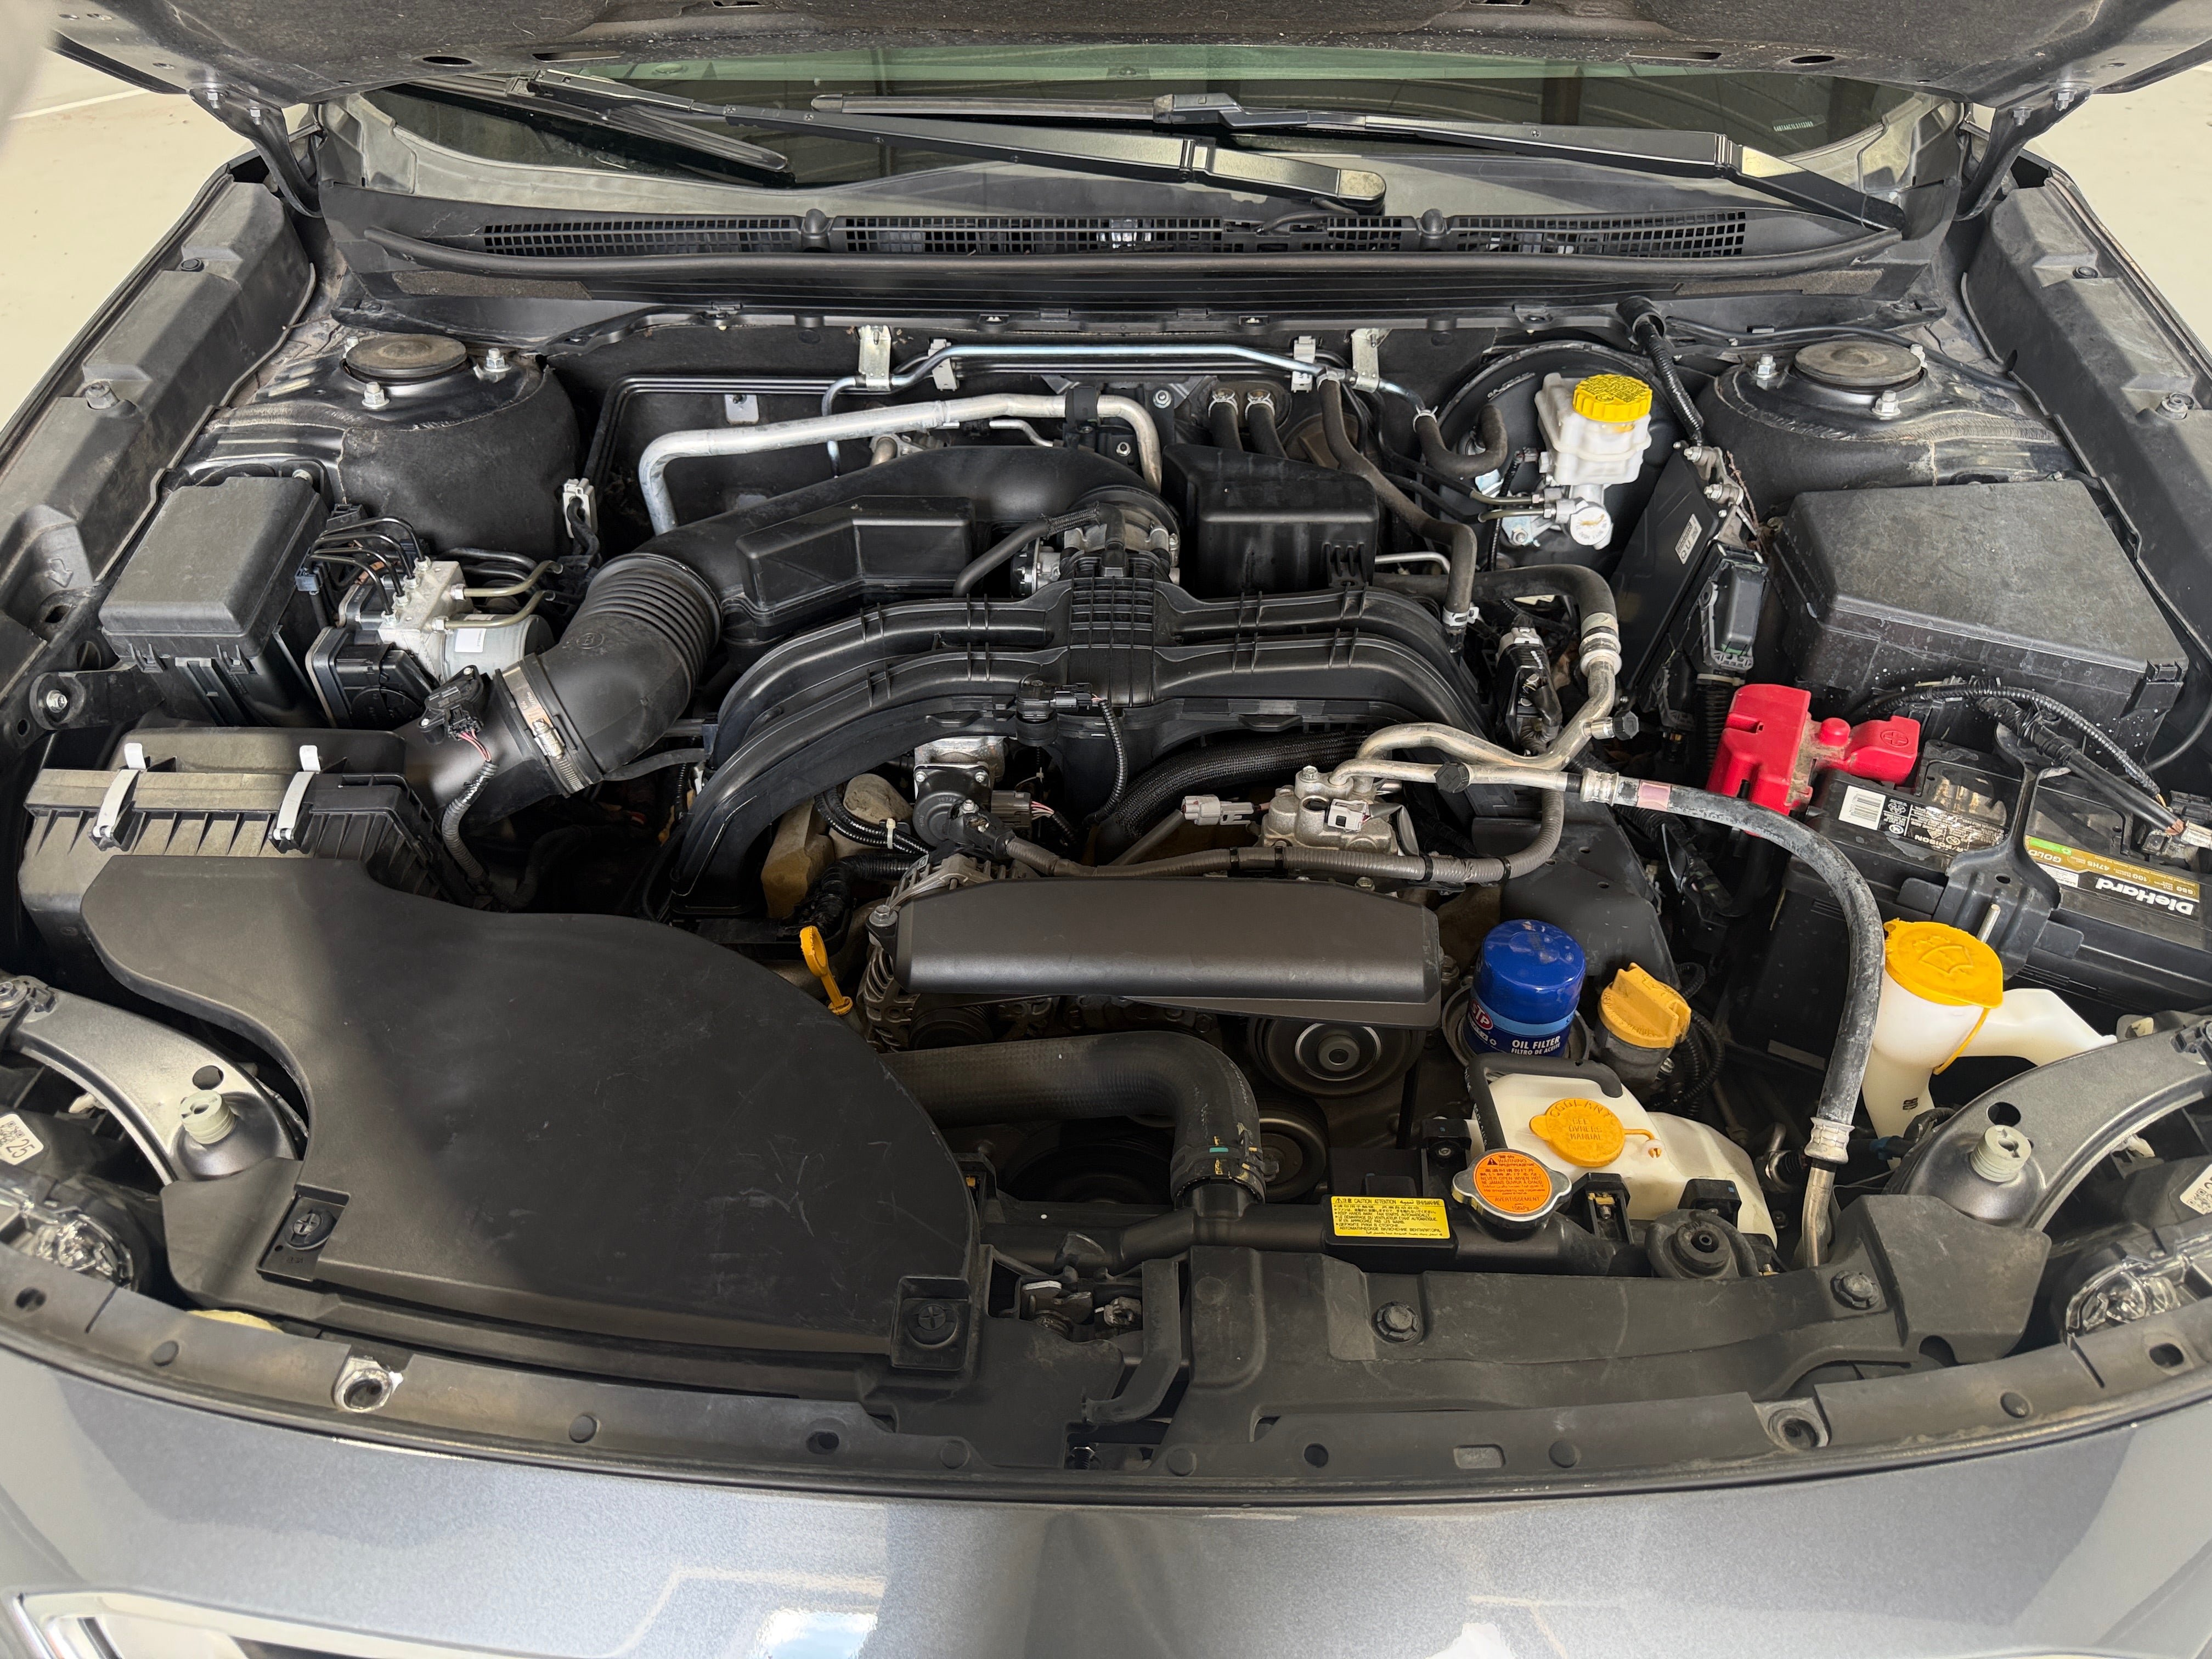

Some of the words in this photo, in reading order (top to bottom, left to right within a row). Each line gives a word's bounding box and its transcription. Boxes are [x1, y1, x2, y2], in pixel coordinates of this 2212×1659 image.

[2028, 849, 2062, 864] GOLD
[2132, 873, 2147, 882] 100
[2095, 878, 2194, 916] DieHard
[1472, 1003, 1490, 1025] STP
[1512, 1040, 1529, 1049] OIL
[1533, 1036, 1561, 1049] FILTER
[1543, 1043, 1560, 1053] ACEITE
[1550, 1099, 1613, 1118] COOLANT
[5, 1138, 35, 1158] 25
